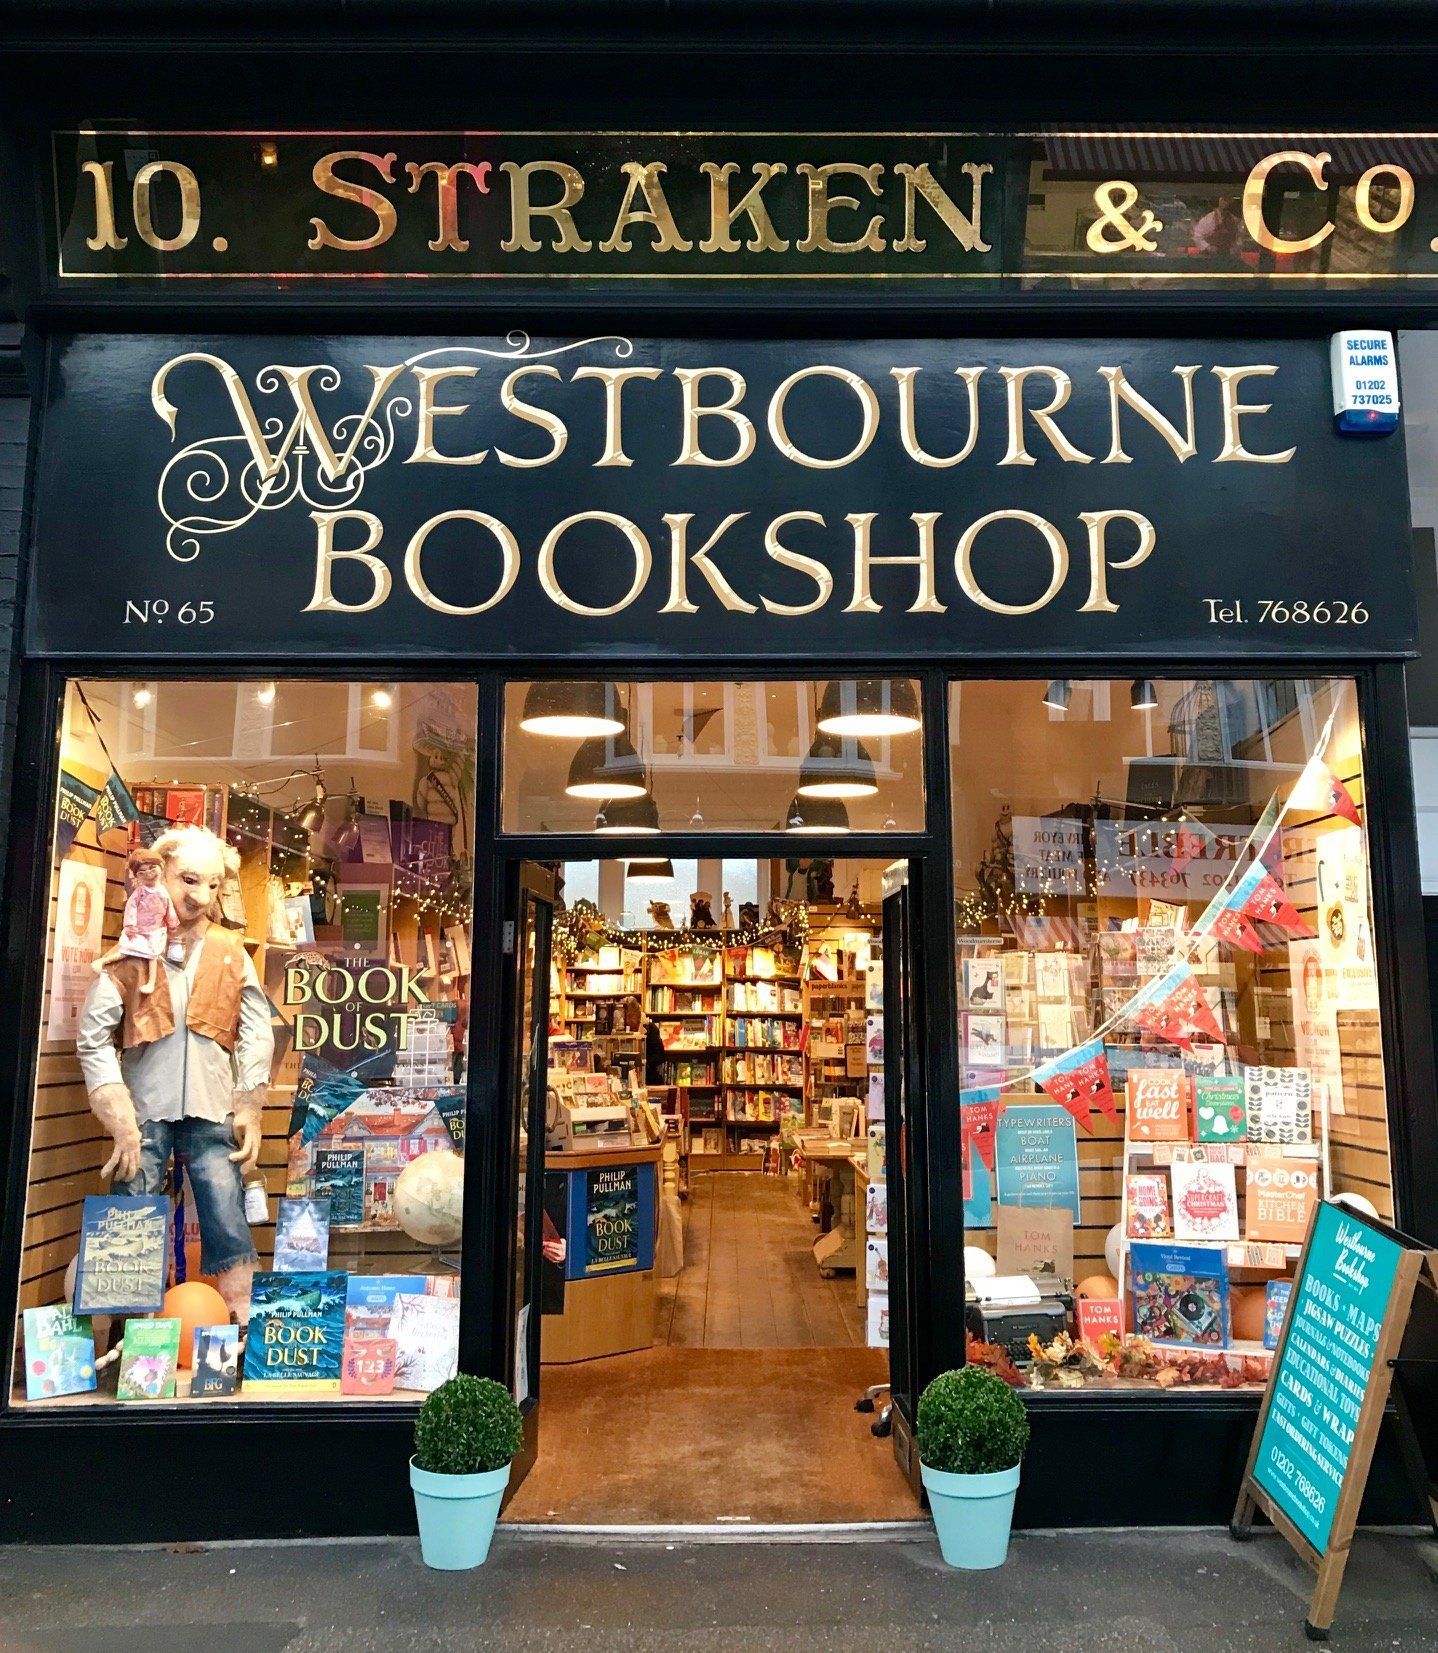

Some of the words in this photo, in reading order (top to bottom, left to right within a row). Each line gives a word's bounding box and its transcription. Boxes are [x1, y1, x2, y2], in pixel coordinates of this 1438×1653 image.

[81, 160, 229, 253] 10.
[306, 150, 994, 254] STRAKEN
[1085, 179, 1167, 254] &
[1346, 339, 1388, 351] SECURE
[1349, 355, 1389, 366] ALARMS
[1356, 380, 1386, 390] 01202
[1351, 394, 1393, 405] 737025
[151, 330, 1297, 512] WESTBOURNE
[301, 508, 1157, 617] BOOKSHOP
[177, 600, 216, 626] 65
[1202, 599, 1250, 625] Tel.
[1257, 600, 1371, 626] 768626
[60, 798, 86, 821] BOOK
[60, 812, 82, 828] DUST
[1250, 888, 1266, 905] TOM
[1255, 888, 1277, 915] HANKS
[344, 957, 370, 969] THE
[283, 966, 431, 1006] BOOK
[811, 982, 848, 991] paperblanks
[345, 1001, 363, 1012] OF
[293, 1012, 420, 1051] DUST
[1078, 1063, 1097, 1076] TOM
[1078, 1068, 1104, 1086] HANKS
[1054, 1081, 1074, 1094] HANK
[1133, 1078, 1180, 1109] fast
[1201, 1090, 1241, 1102] Christmas
[966, 1113, 994, 1122] HANKS
[969, 1106, 988, 1114] TOM
[1136, 1100, 1181, 1120] well
[997, 1117, 1072, 1128] TYPEWRITERS
[1021, 1135, 1050, 1146] BOAT
[321, 1160, 358, 1169] PULLMAN
[327, 1153, 353, 1161] PHILIP
[1010, 1153, 1063, 1164] AIRPLANE
[599, 1170, 626, 1183] PHILIP
[1019, 1171, 1057, 1182] PIANO
[593, 1180, 632, 1194] PULLMAN
[1258, 1199, 1306, 1212] KITCHEN
[1257, 1208, 1306, 1223] BIBLE
[596, 1219, 633, 1237] BOOK
[1023, 1230, 1051, 1239] TOM
[598, 1235, 630, 1252] DUST
[1014, 1244, 1058, 1253] HANKS
[1335, 1220, 1376, 1263] Westbourne
[95, 1260, 148, 1275] BOOK
[1335, 1247, 1370, 1295] Bookshop
[97, 1277, 144, 1292] DUST
[1089, 1305, 1112, 1314] TOM
[1305, 1273, 1341, 1312] BOOKS
[1346, 1303, 1382, 1343] MAPS
[1084, 1315, 1119, 1325] HANKS
[264, 1326, 328, 1344] BOOK
[1303, 1298, 1336, 1330] JIGSAW
[1333, 1320, 1371, 1359] PUZZLES
[1295, 1314, 1328, 1347] JOURNALS
[1331, 1342, 1370, 1383] NOTEBOOKS
[266, 1347, 323, 1366] DUST
[356, 1359, 385, 1374] 123
[1291, 1332, 1331, 1372] CALENDARS
[1335, 1366, 1366, 1402] DIARIES
[1285, 1346, 1340, 1404] EDUCATIONAL
[1339, 1392, 1362, 1423] TOYS
[1281, 1369, 1314, 1408] CARDS
[1313, 1399, 1322, 1416] &
[1322, 1404, 1355, 1446] WRAP
[1276, 1392, 1297, 1418] GIFTS
[1301, 1416, 1320, 1439] GIFT
[1318, 1431, 1349, 1470] TOKENS
[1271, 1407, 1288, 1430] FAST
[1285, 1421, 1319, 1462] ORDERING
[1315, 1452, 1345, 1489] SERVICE
[1271, 1445, 1295, 1480] 01202
[1294, 1469, 1326, 1514] 768626
